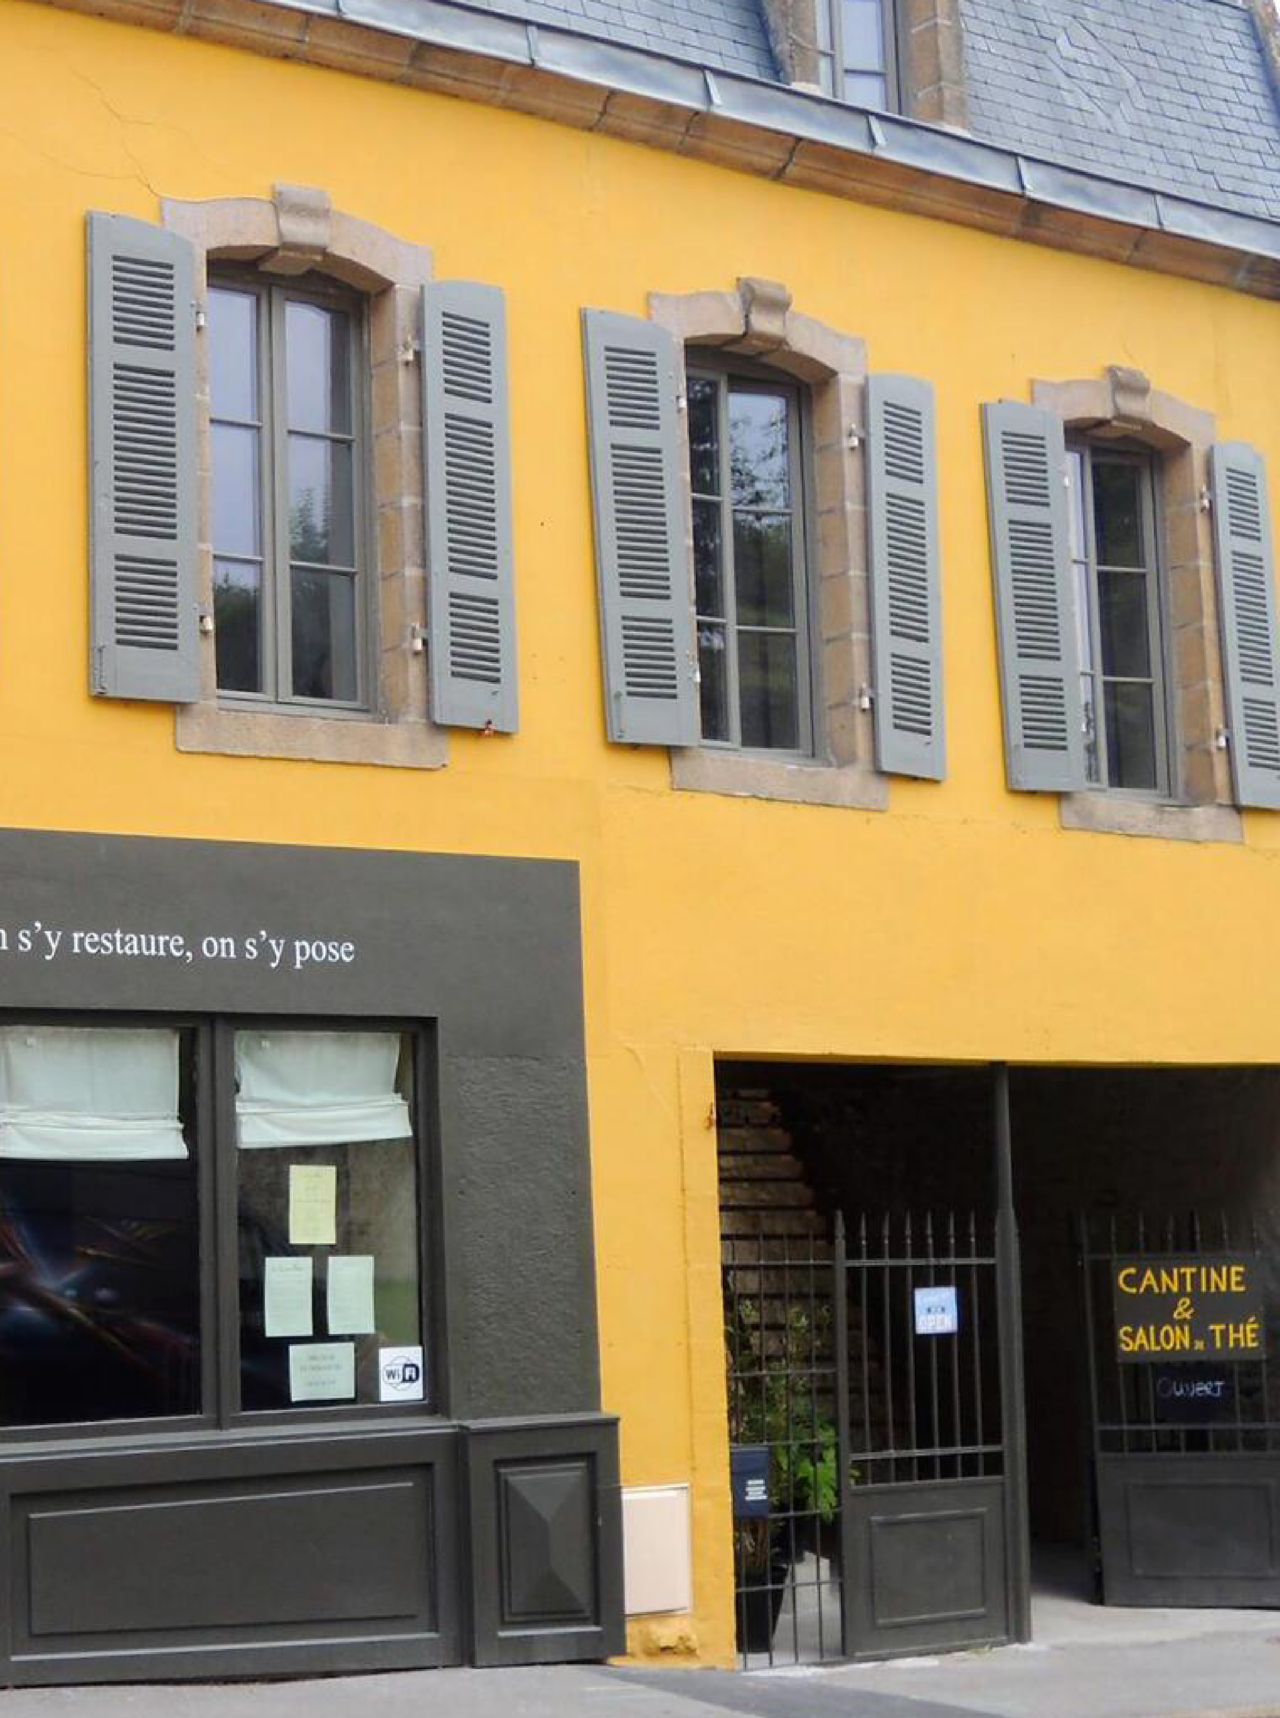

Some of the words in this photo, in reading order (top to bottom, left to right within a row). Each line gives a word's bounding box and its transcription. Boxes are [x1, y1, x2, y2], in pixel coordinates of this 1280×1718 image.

[71, 927, 193, 964] restaure,
[201, 935, 237, 959] on
[293, 939, 355, 970] pose
[1118, 1265, 1246, 1294] CANTINE
[1172, 1296, 1195, 1321] &
[1119, 1324, 1191, 1351] SALON
[1209, 1315, 1261, 1349] THÉ
